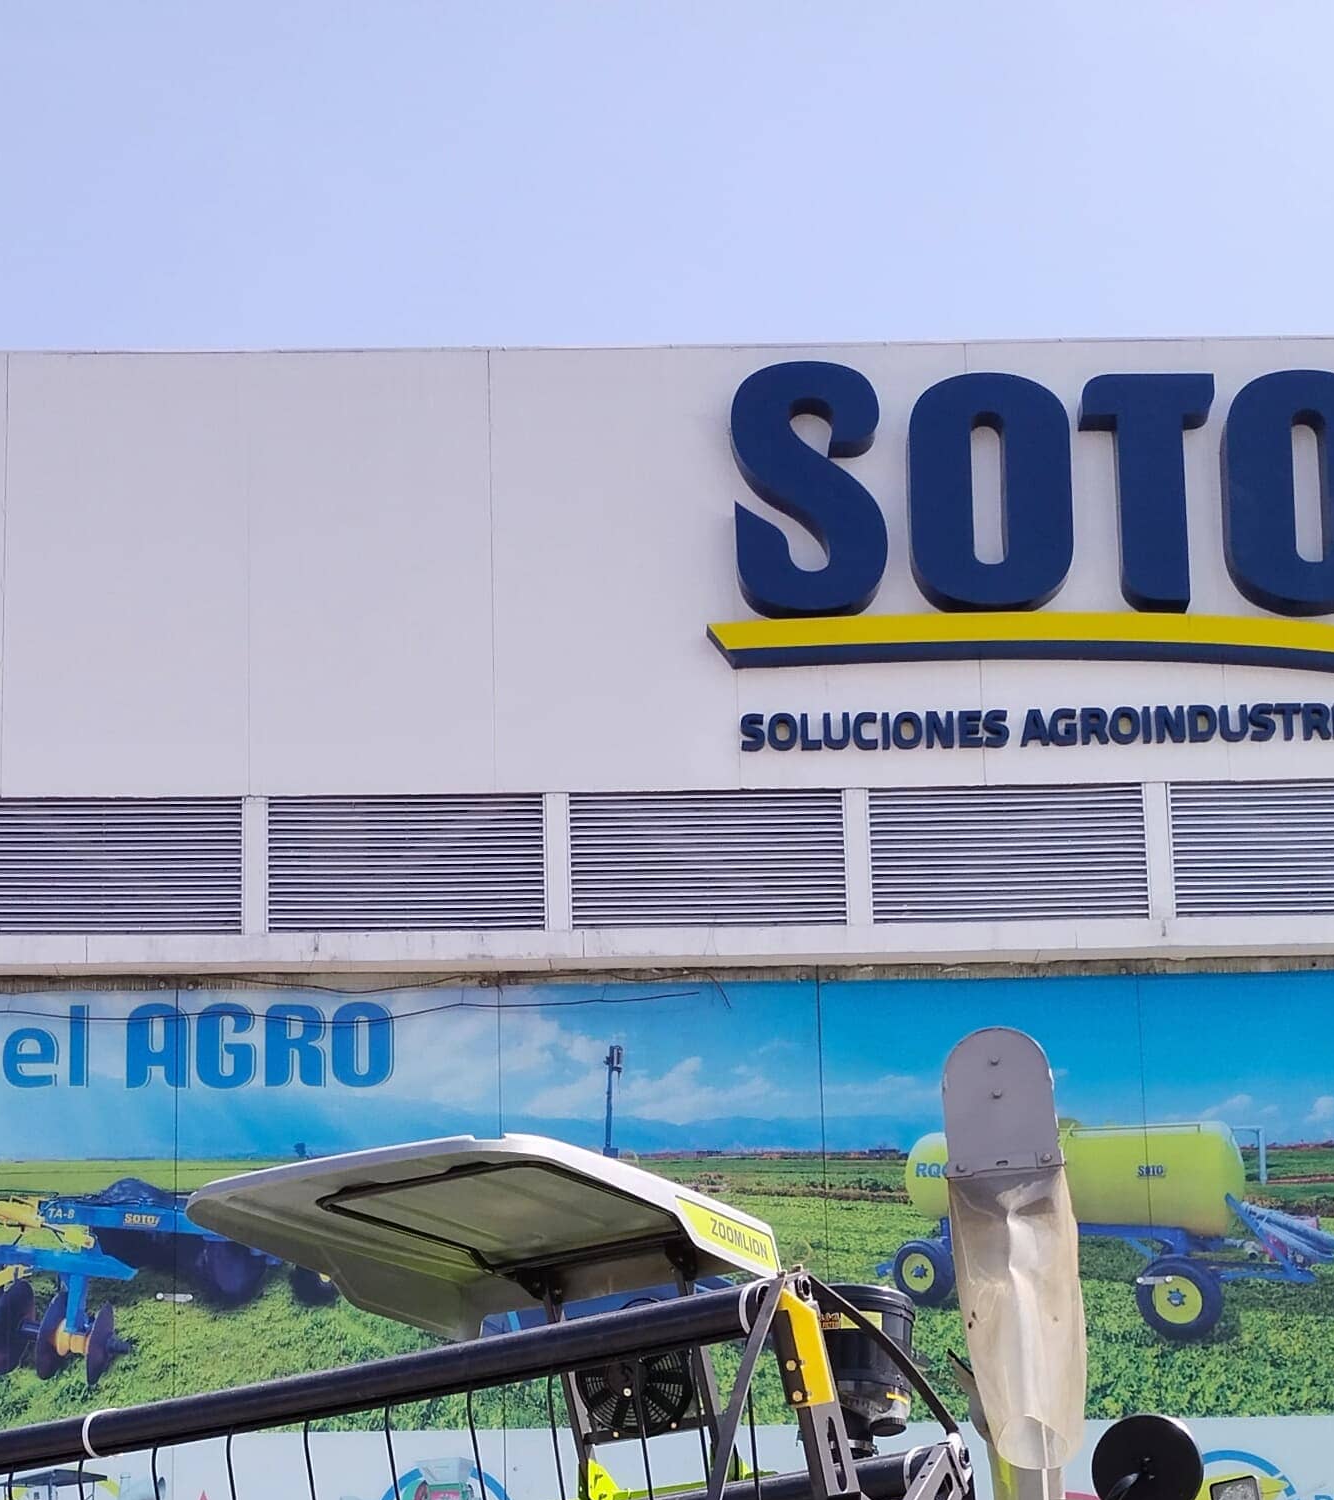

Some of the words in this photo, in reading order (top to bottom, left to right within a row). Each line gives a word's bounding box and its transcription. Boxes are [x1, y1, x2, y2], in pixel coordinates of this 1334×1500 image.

[740, 709, 1009, 752] SOLUCIONES
[2, 1004, 90, 1089] el
[123, 1001, 396, 1090] AGRO
[915, 1162, 948, 1178] RQ
[1137, 1164, 1165, 1177] SOTO
[123, 1212, 156, 1225] SOTO
[709, 1216, 769, 1261] ZOOMLION
